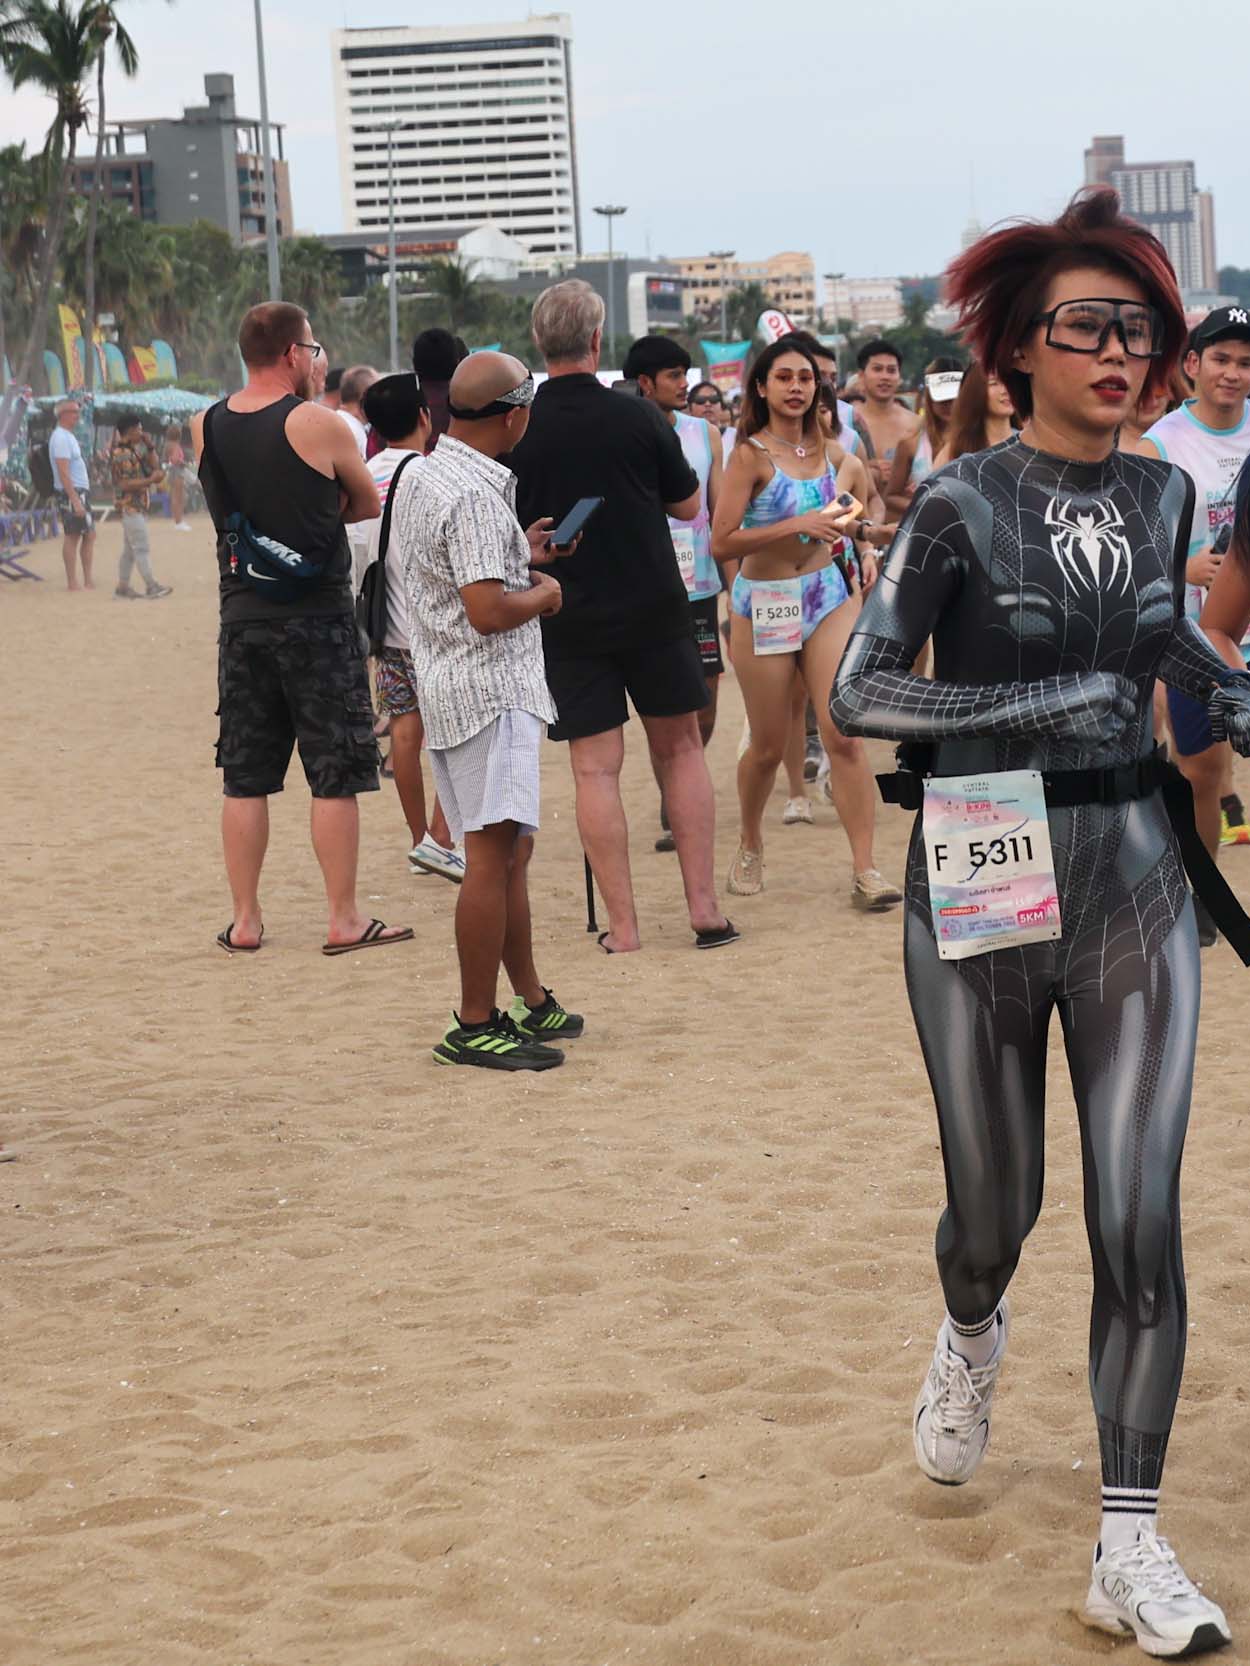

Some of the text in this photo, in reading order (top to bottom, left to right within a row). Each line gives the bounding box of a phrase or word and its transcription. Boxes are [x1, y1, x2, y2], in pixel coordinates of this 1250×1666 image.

[756, 605, 800, 620] F 5230
[934, 836, 1033, 871] F 5311
[1020, 911, 1044, 923] 5KM
